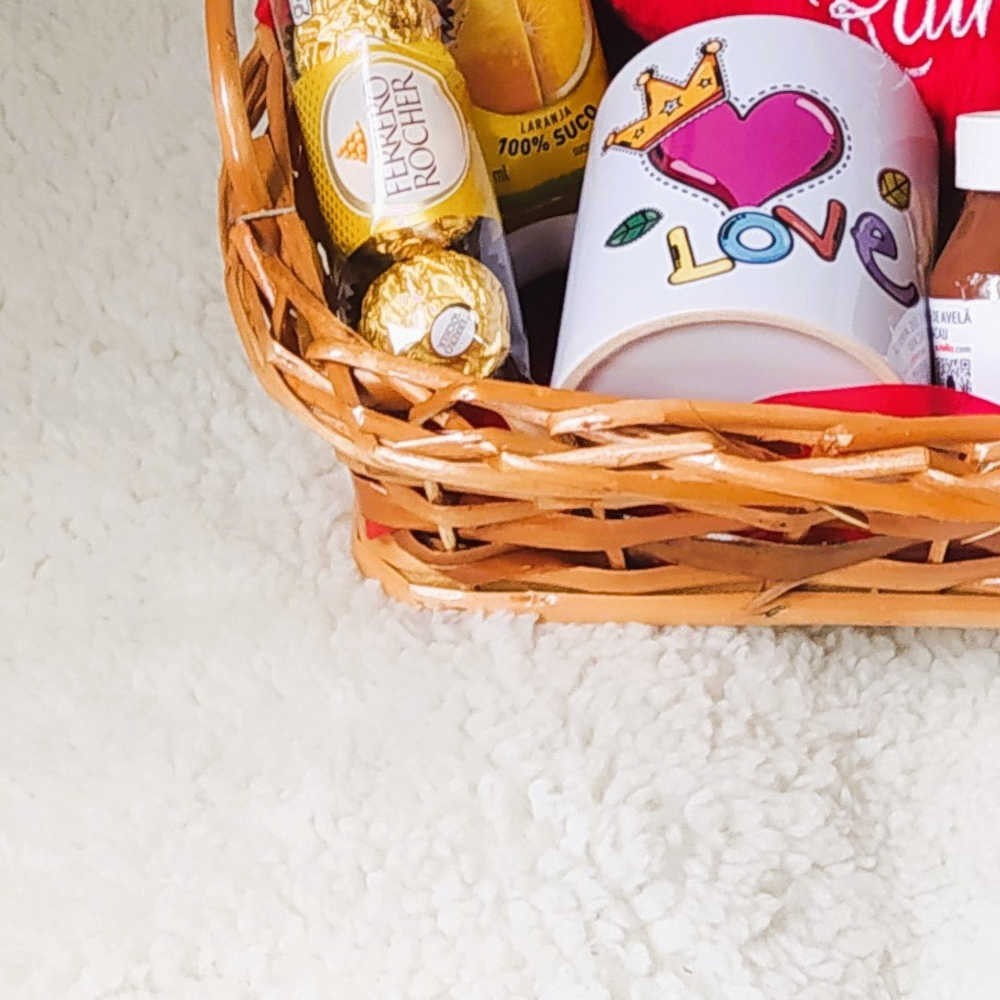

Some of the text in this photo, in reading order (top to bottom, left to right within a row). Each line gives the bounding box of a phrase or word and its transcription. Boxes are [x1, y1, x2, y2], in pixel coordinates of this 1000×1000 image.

[391, 71, 441, 190] ROCHER
[498, 133, 551, 157] 100%
[553, 104, 598, 147] SUCO
[520, 105, 573, 135] LARANJA
